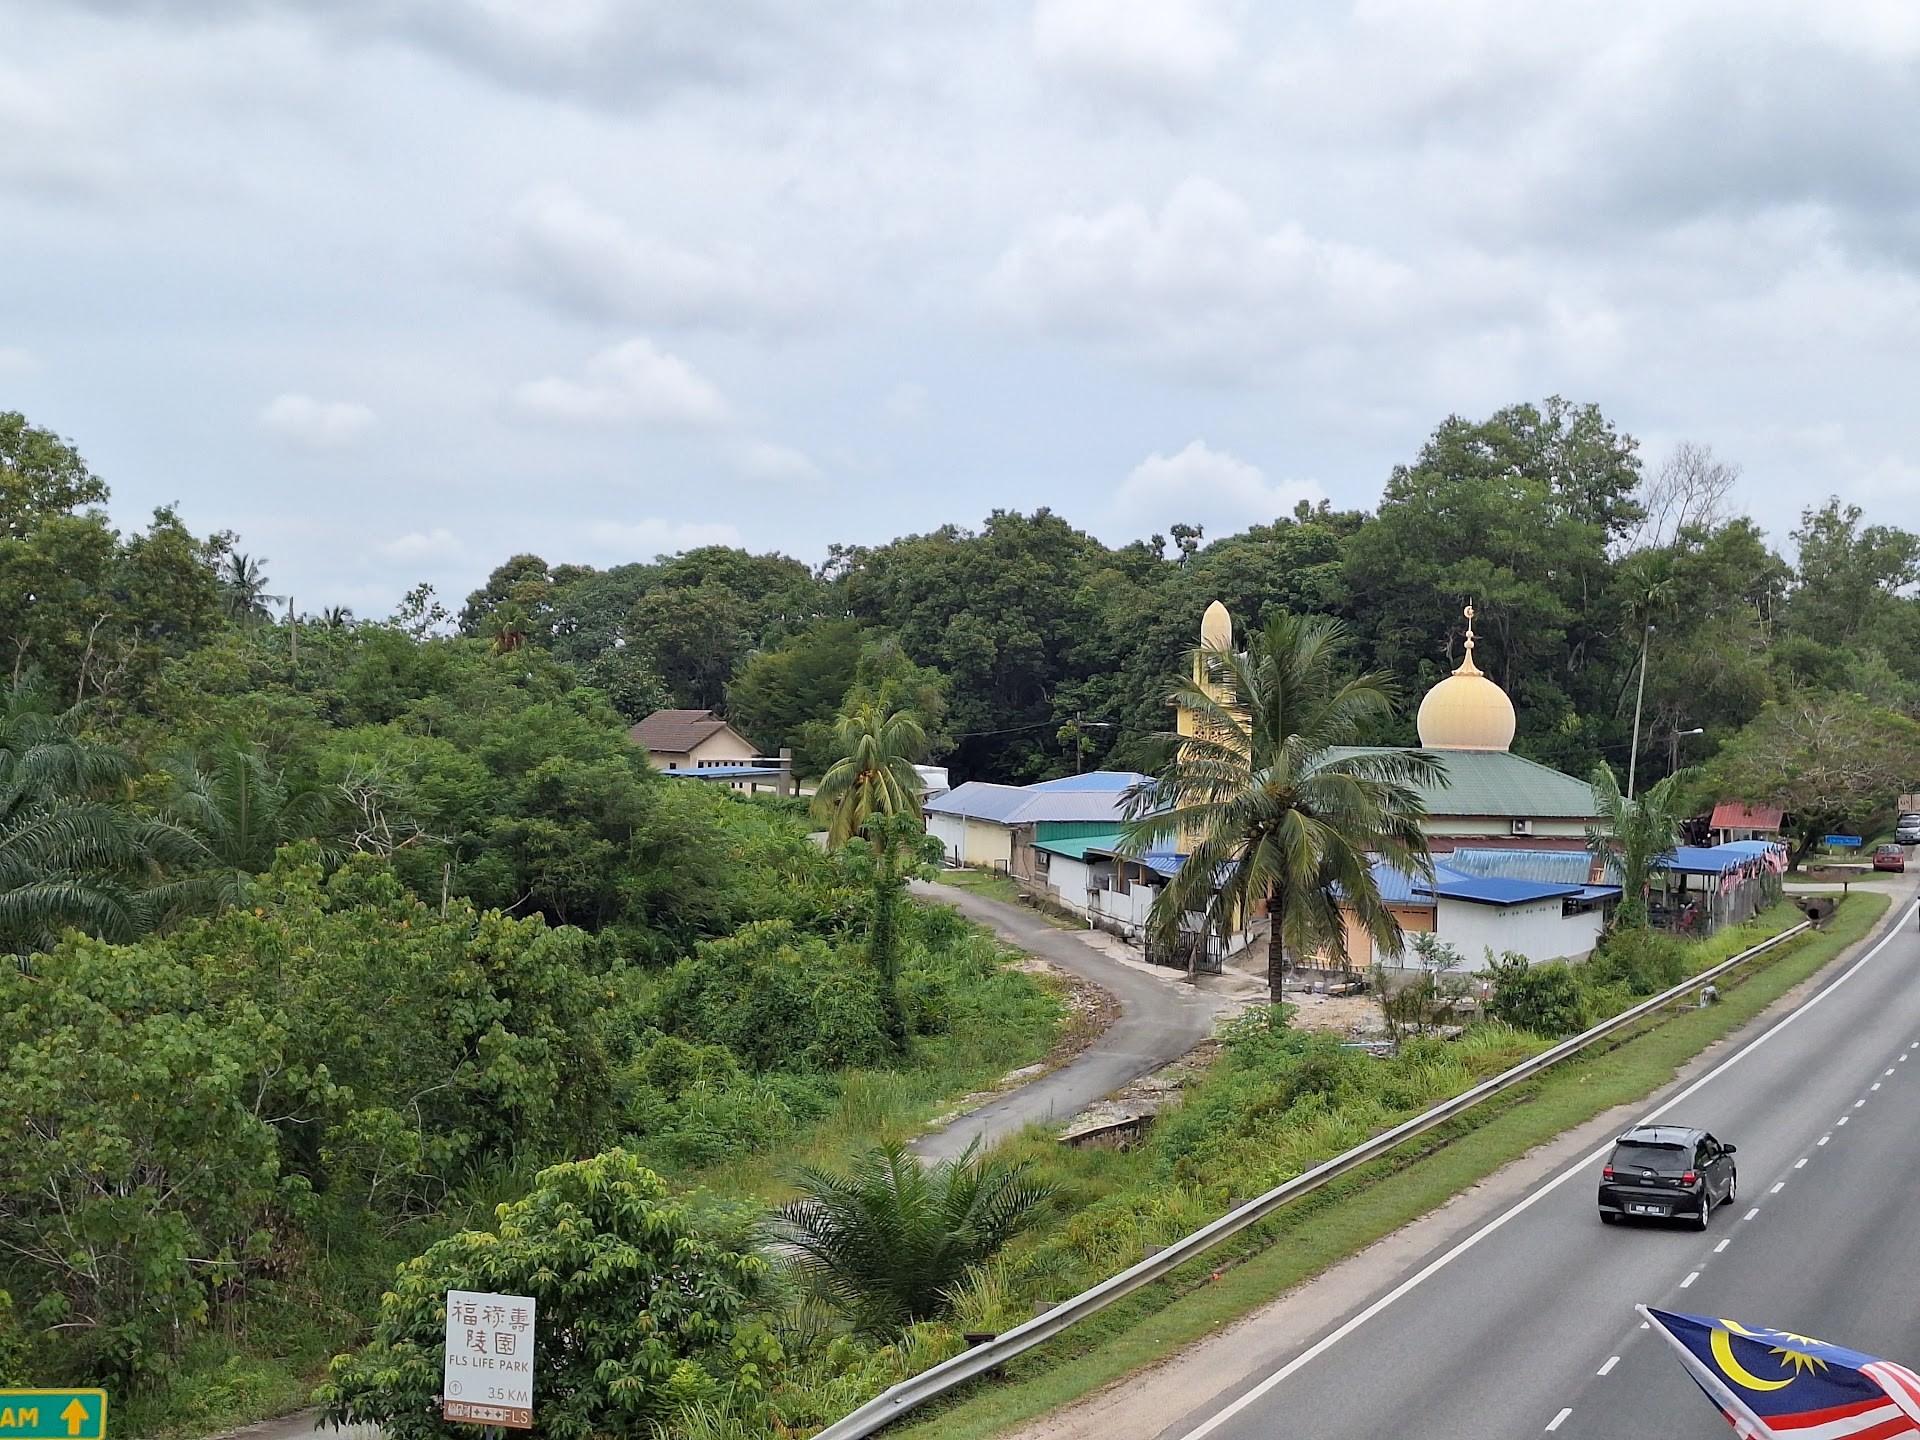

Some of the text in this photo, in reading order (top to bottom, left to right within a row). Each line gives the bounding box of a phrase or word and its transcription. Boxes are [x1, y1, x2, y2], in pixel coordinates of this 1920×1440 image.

[449, 1355, 529, 1372] FLS LIFE PARK
[508, 1389, 528, 1402] KM
[504, 1409, 528, 1424] FLS
